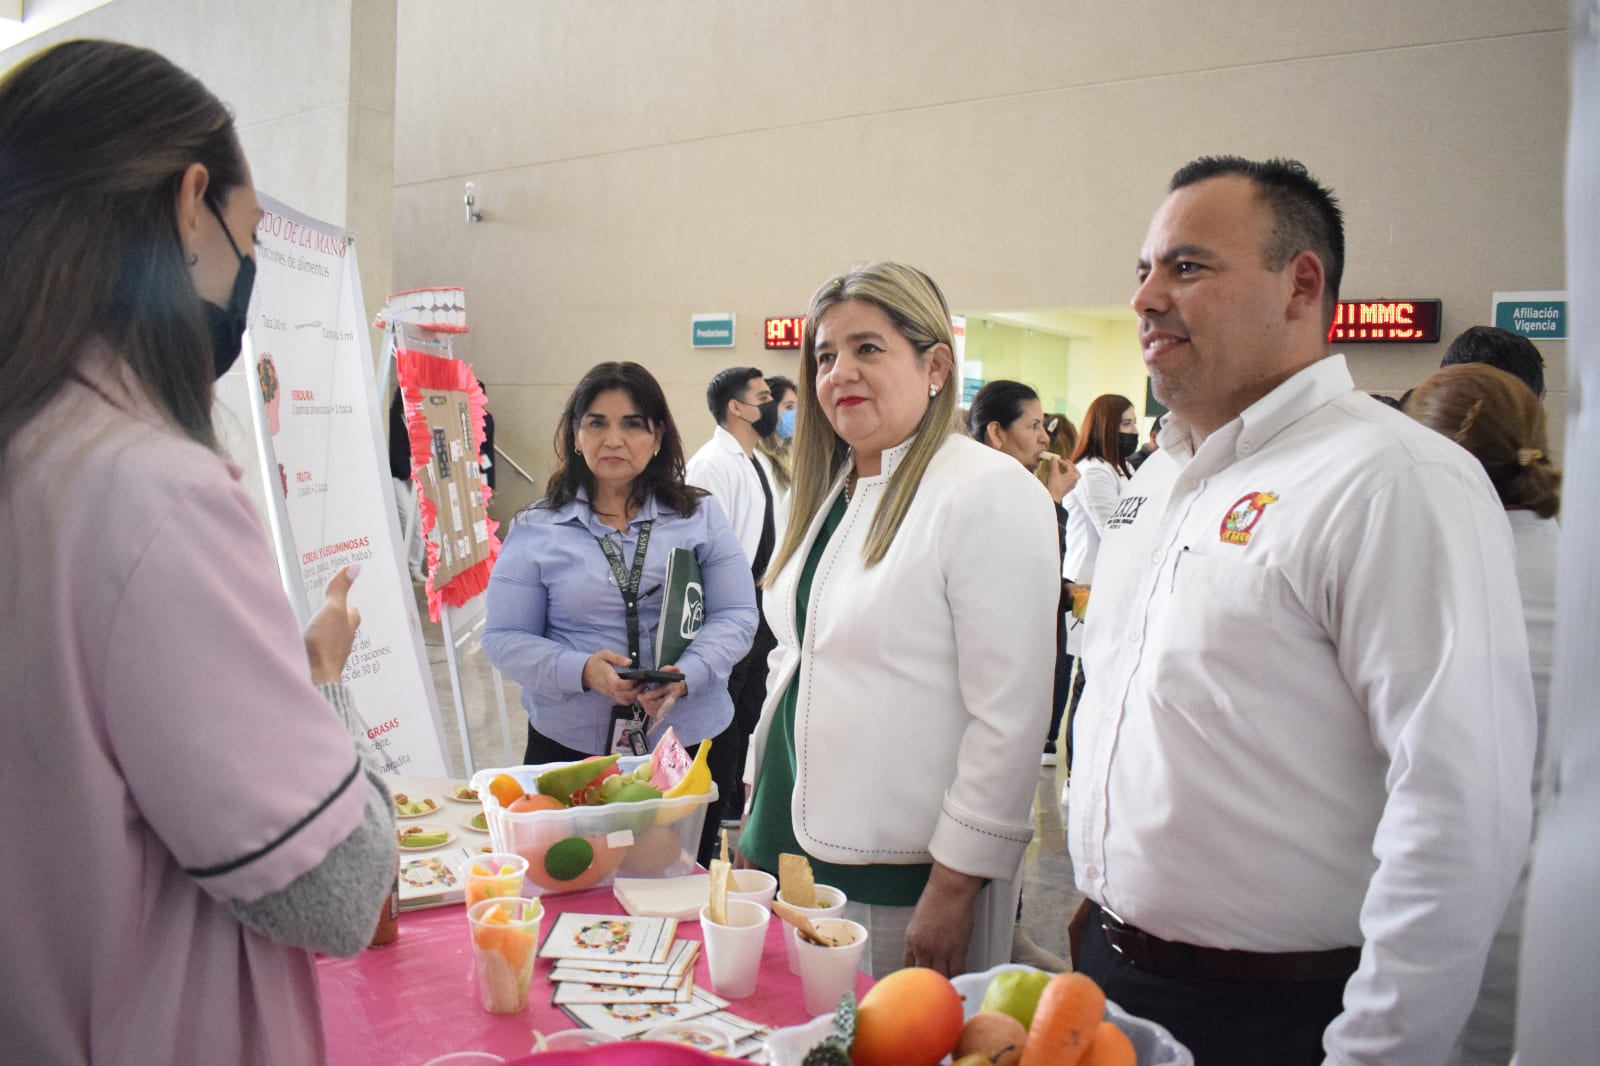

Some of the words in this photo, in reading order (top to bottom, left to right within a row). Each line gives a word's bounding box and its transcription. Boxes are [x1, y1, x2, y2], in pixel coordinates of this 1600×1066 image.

[283, 221, 300, 244] DE
[299, 227, 312, 249] LA
[315, 231, 347, 259] MANO
[1513, 306, 1559, 319] Afiliación
[1514, 319, 1556, 333] Vigencia
[323, 536, 370, 557] LEGUMINOSAS
[637, 533, 649, 554] IMSS
[361, 663, 371, 676] 30
[367, 717, 400, 739] GRASAS
